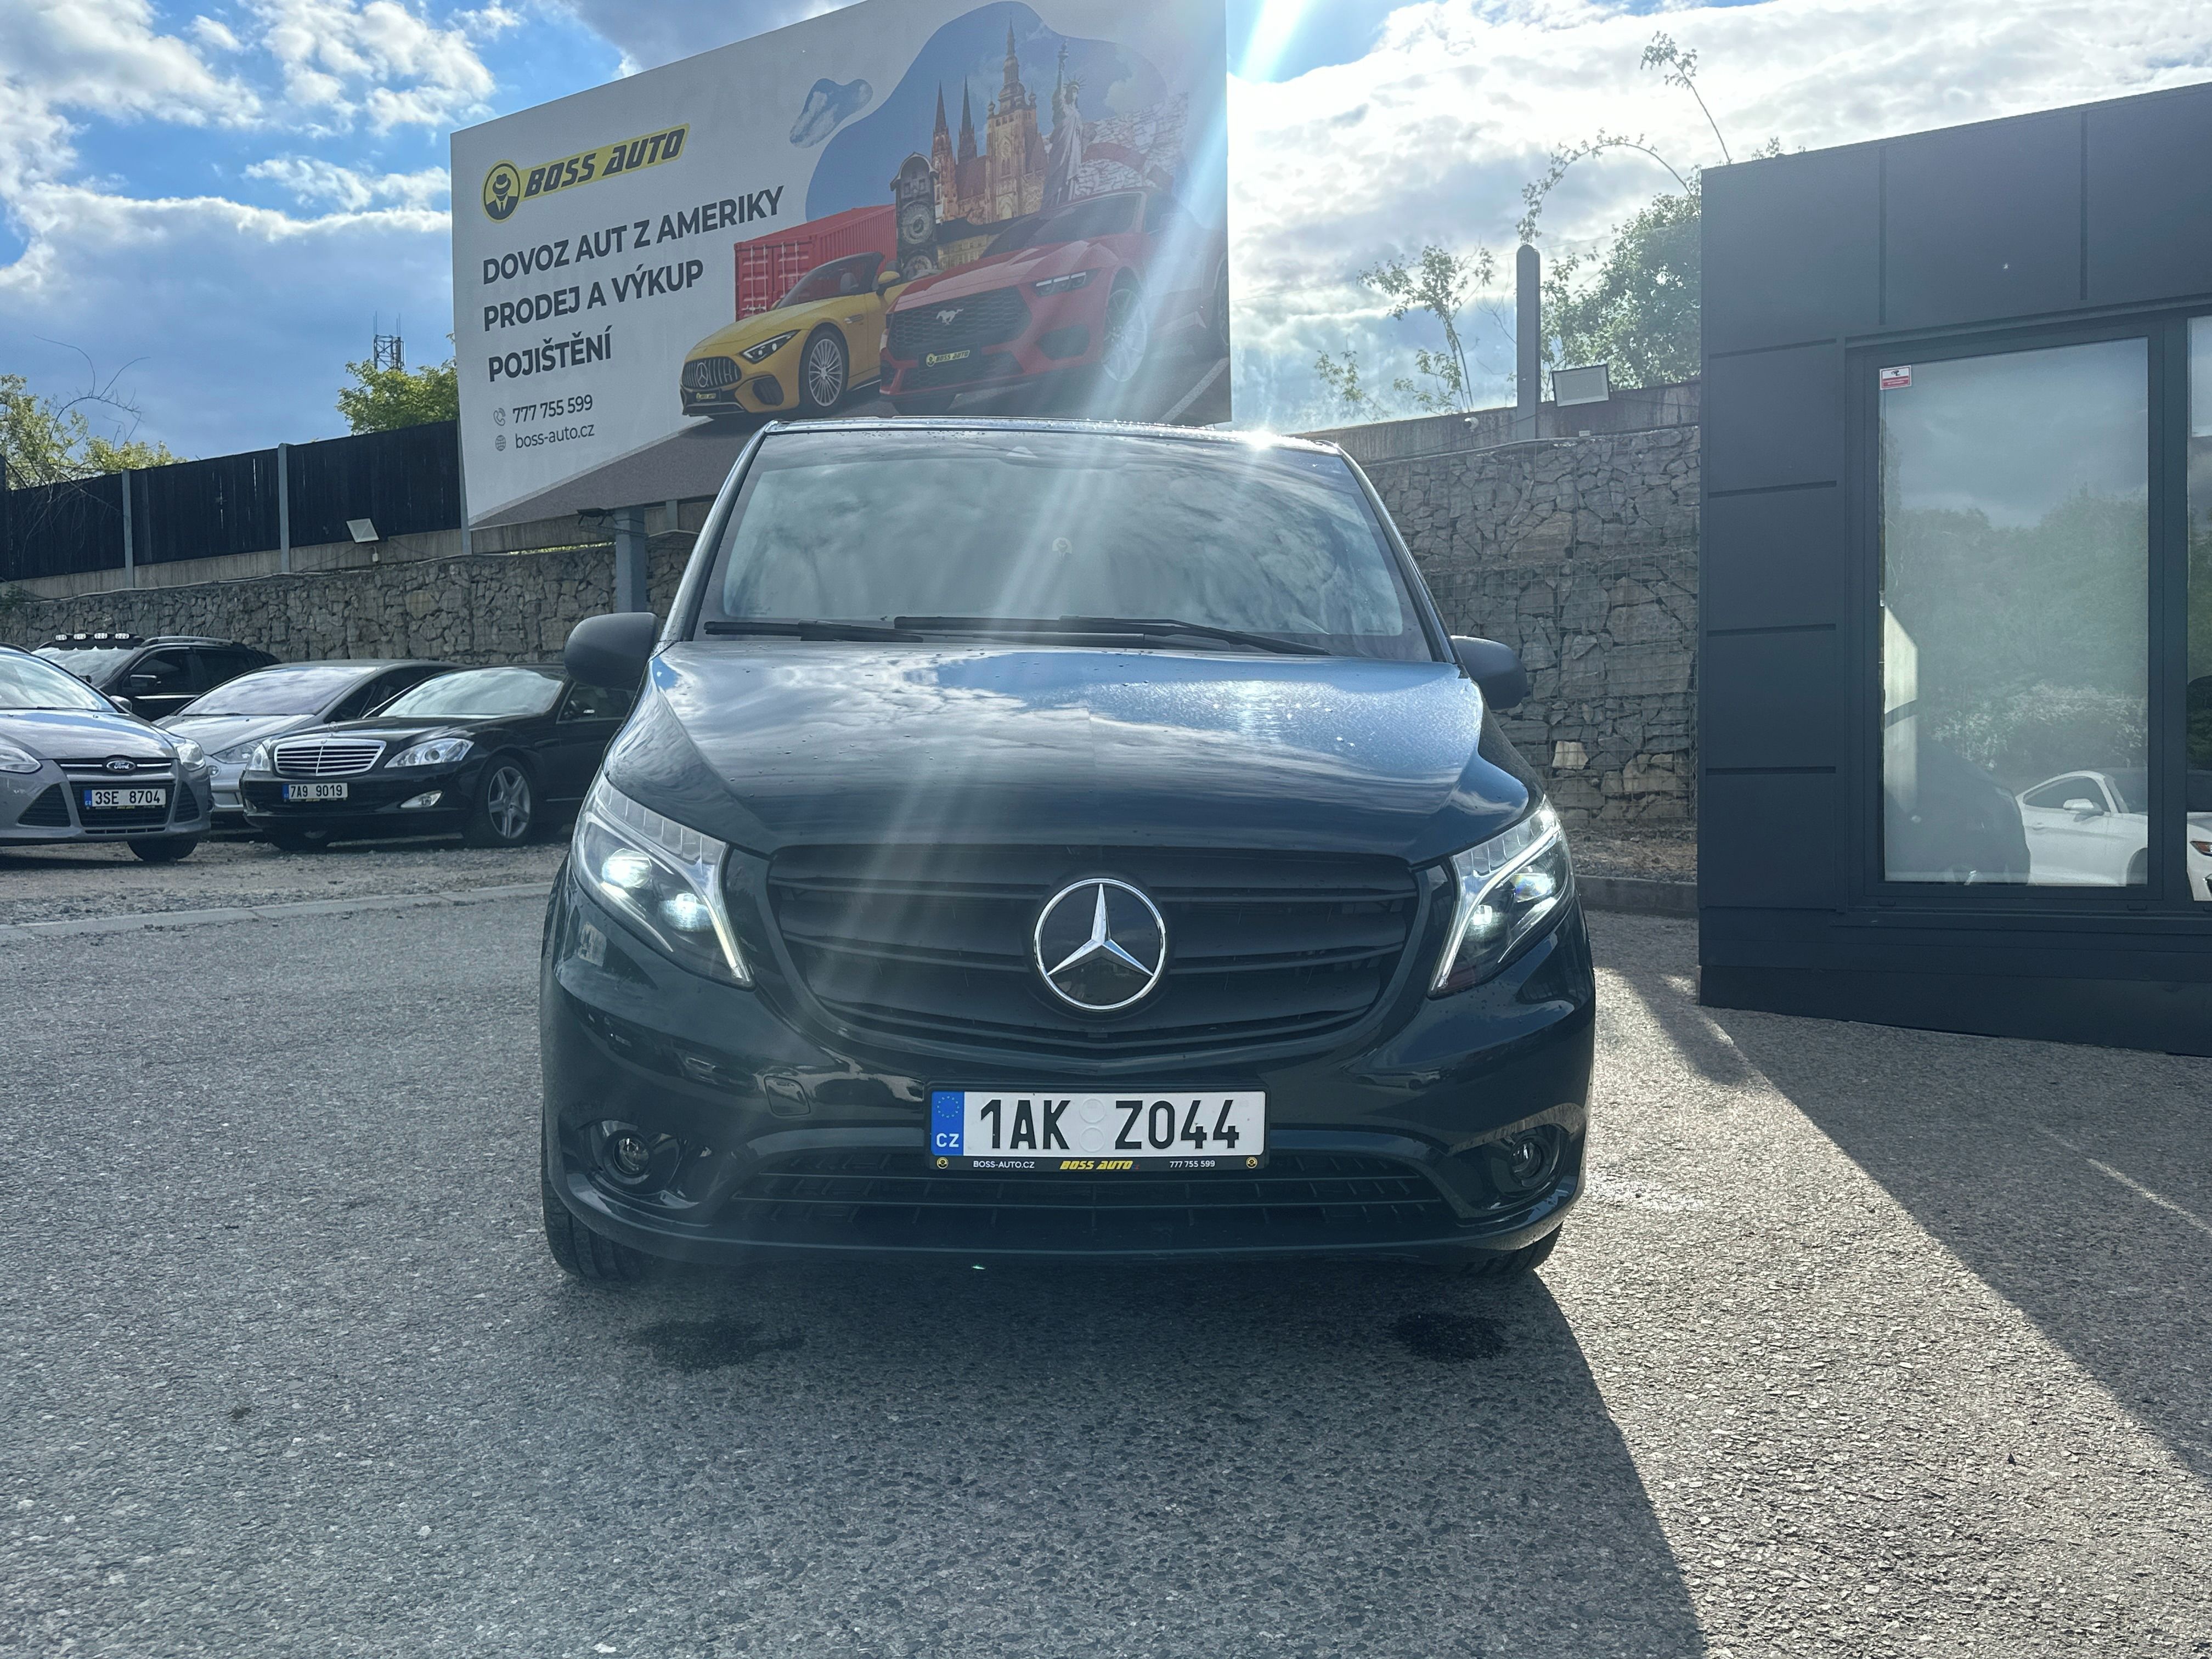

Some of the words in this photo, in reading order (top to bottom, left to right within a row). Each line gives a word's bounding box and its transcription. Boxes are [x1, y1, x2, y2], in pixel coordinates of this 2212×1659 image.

[524, 153, 597, 198] BOSS
[602, 128, 685, 176] AUTO
[483, 239, 569, 285] DOVOZ
[575, 225, 627, 263] AUT
[634, 219, 651, 249] Z
[656, 185, 784, 244] AMERIKY
[484, 286, 580, 331] PRODEJ
[587, 282, 607, 309] A
[611, 259, 703, 303] VÝKUP
[488, 325, 613, 382] POJIŠTĚNÍ
[512, 404, 537, 424] 777
[540, 399, 564, 419] 755
[567, 394, 592, 413] 599
[515, 424, 595, 449] boss-auto.cz
[95, 791, 119, 805] 3SE
[129, 791, 160, 803] 8704
[291, 786, 308, 798] 7A9
[315, 785, 342, 797] 9019
[980, 1099, 1070, 1149] 1AK
[1115, 1099, 1239, 1149] Z044
[936, 1133, 959, 1148] CZ
[973, 1160, 1035, 1169] BOSS-AUTO.CZ
[1059, 1160, 1095, 1170] BOSS
[1096, 1160, 1133, 1170] AUTO
